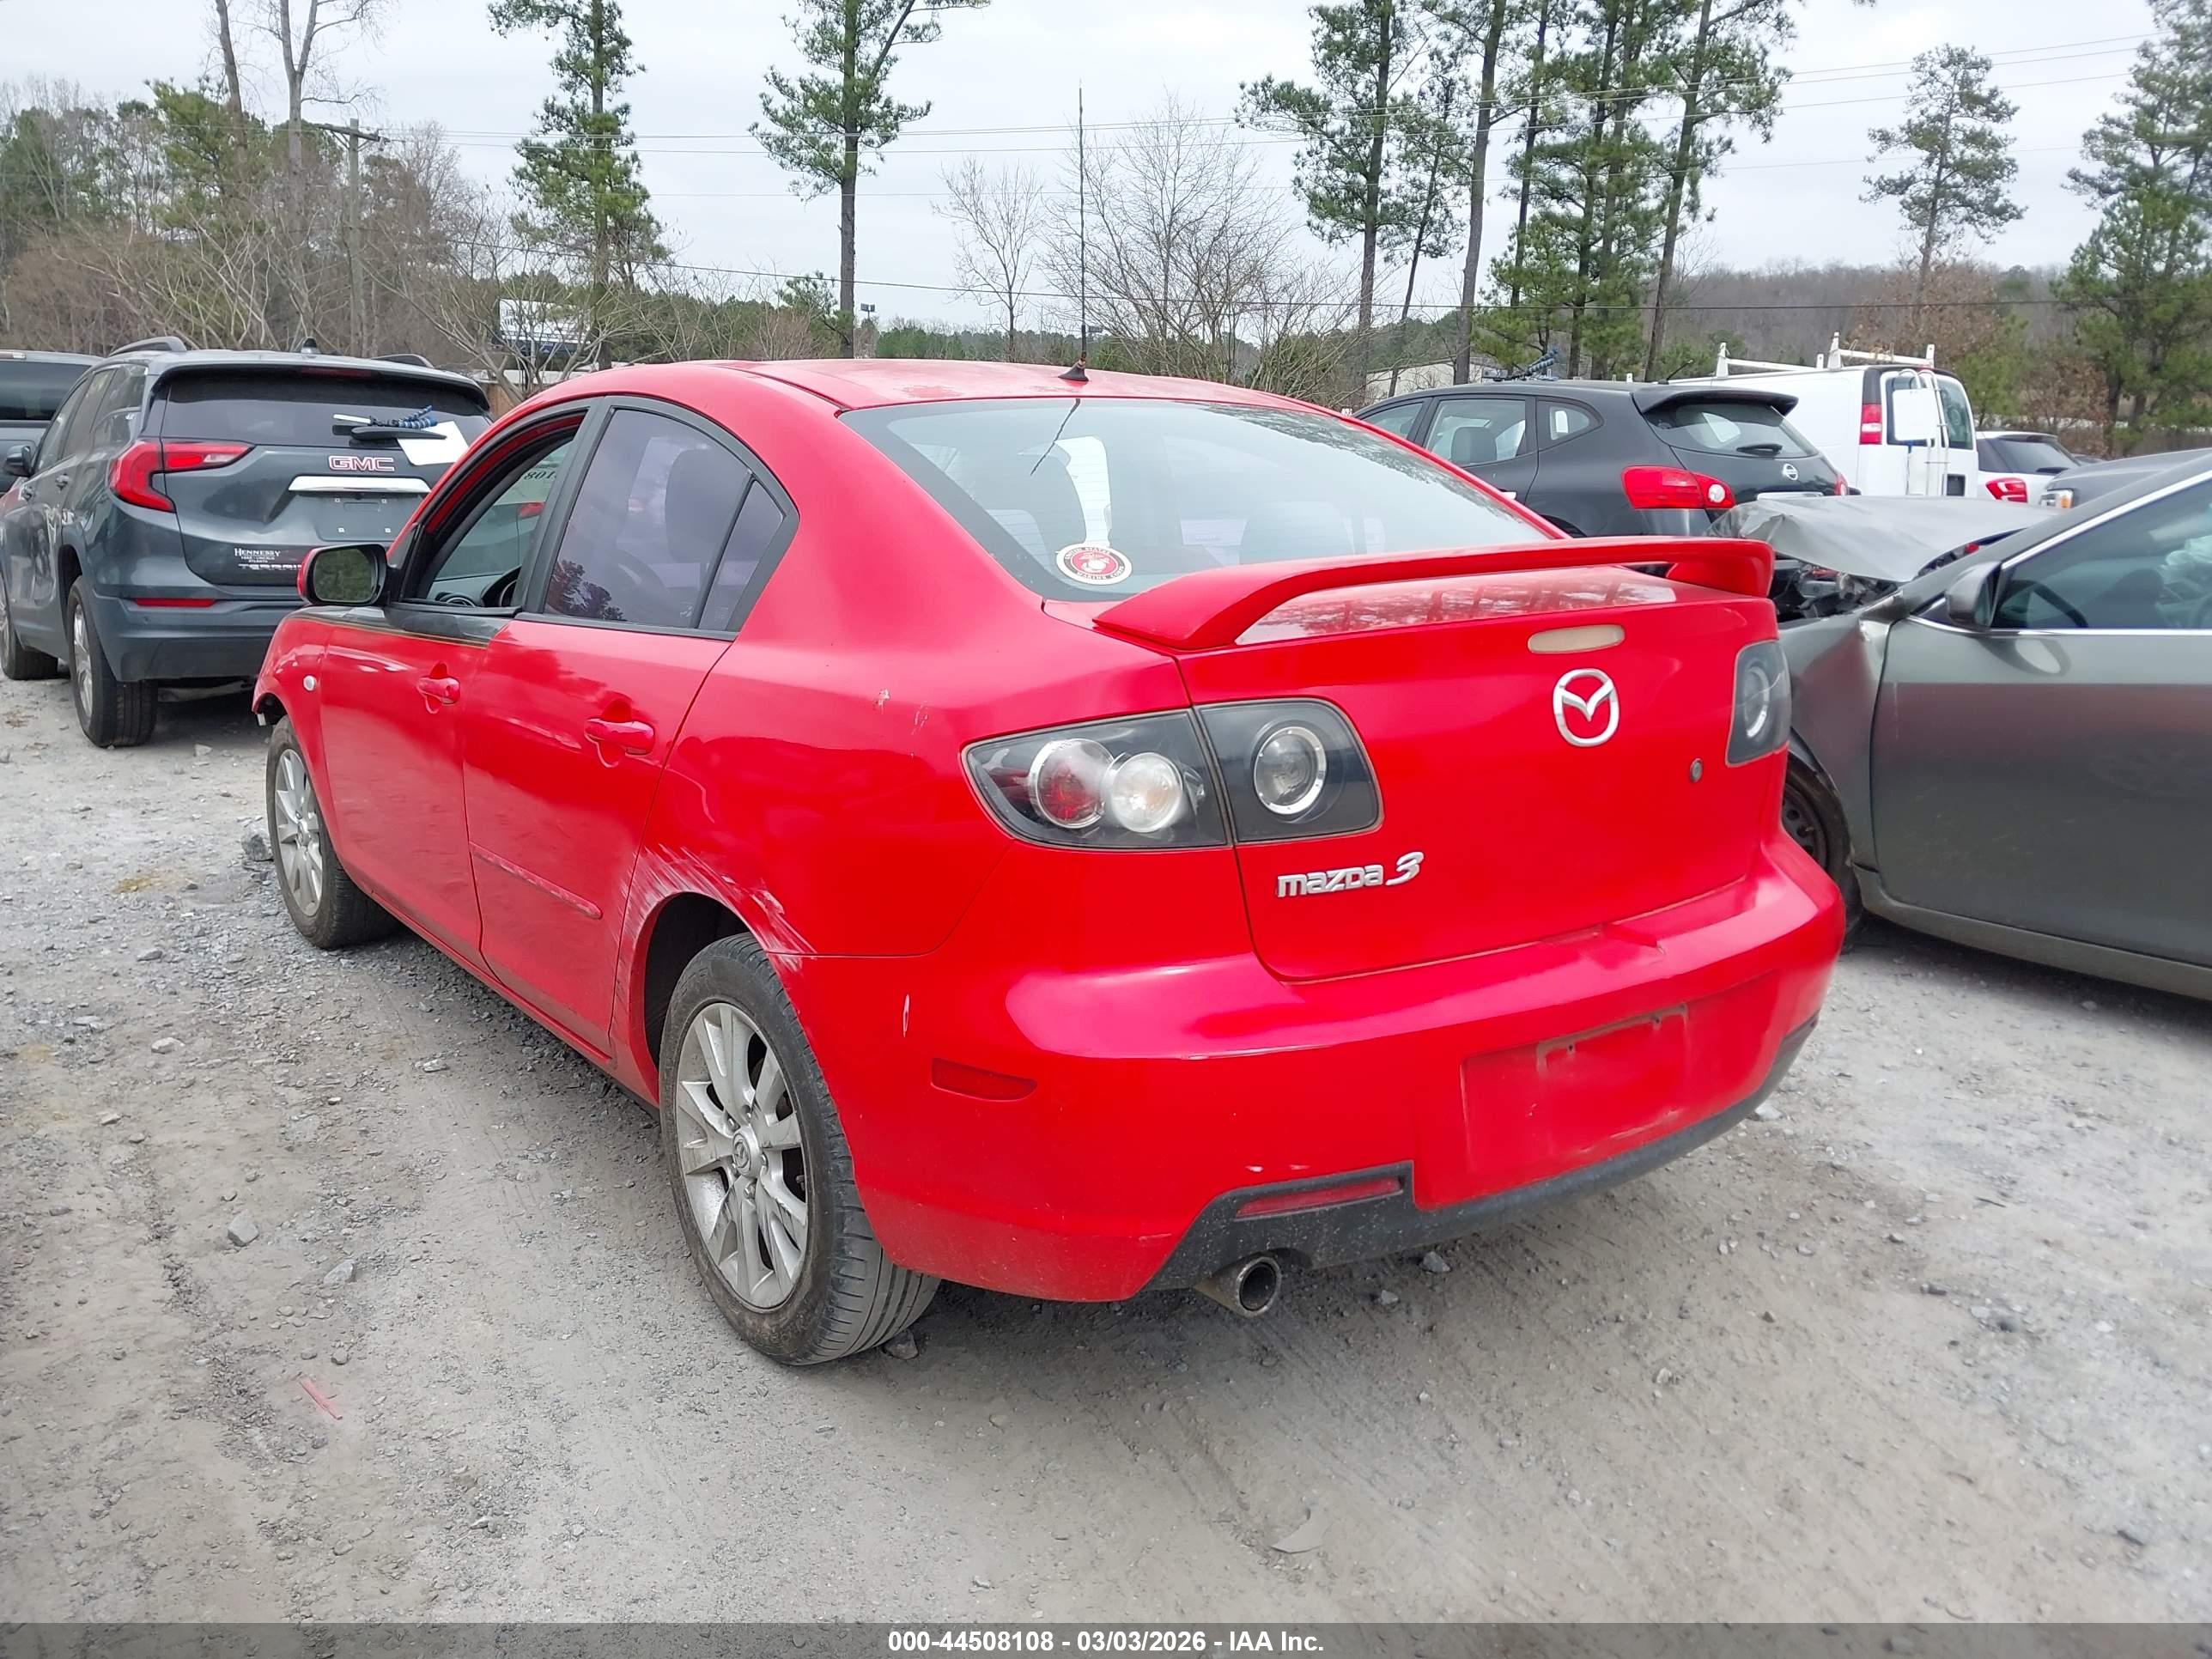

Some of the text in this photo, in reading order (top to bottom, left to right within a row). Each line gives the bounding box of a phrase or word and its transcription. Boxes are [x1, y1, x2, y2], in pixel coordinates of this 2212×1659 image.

[329, 455, 395, 472] GMC
[524, 471, 557, 480] 801
[234, 548, 281, 557] HENNESSY
[1277, 851, 1425, 898] mazda 3
